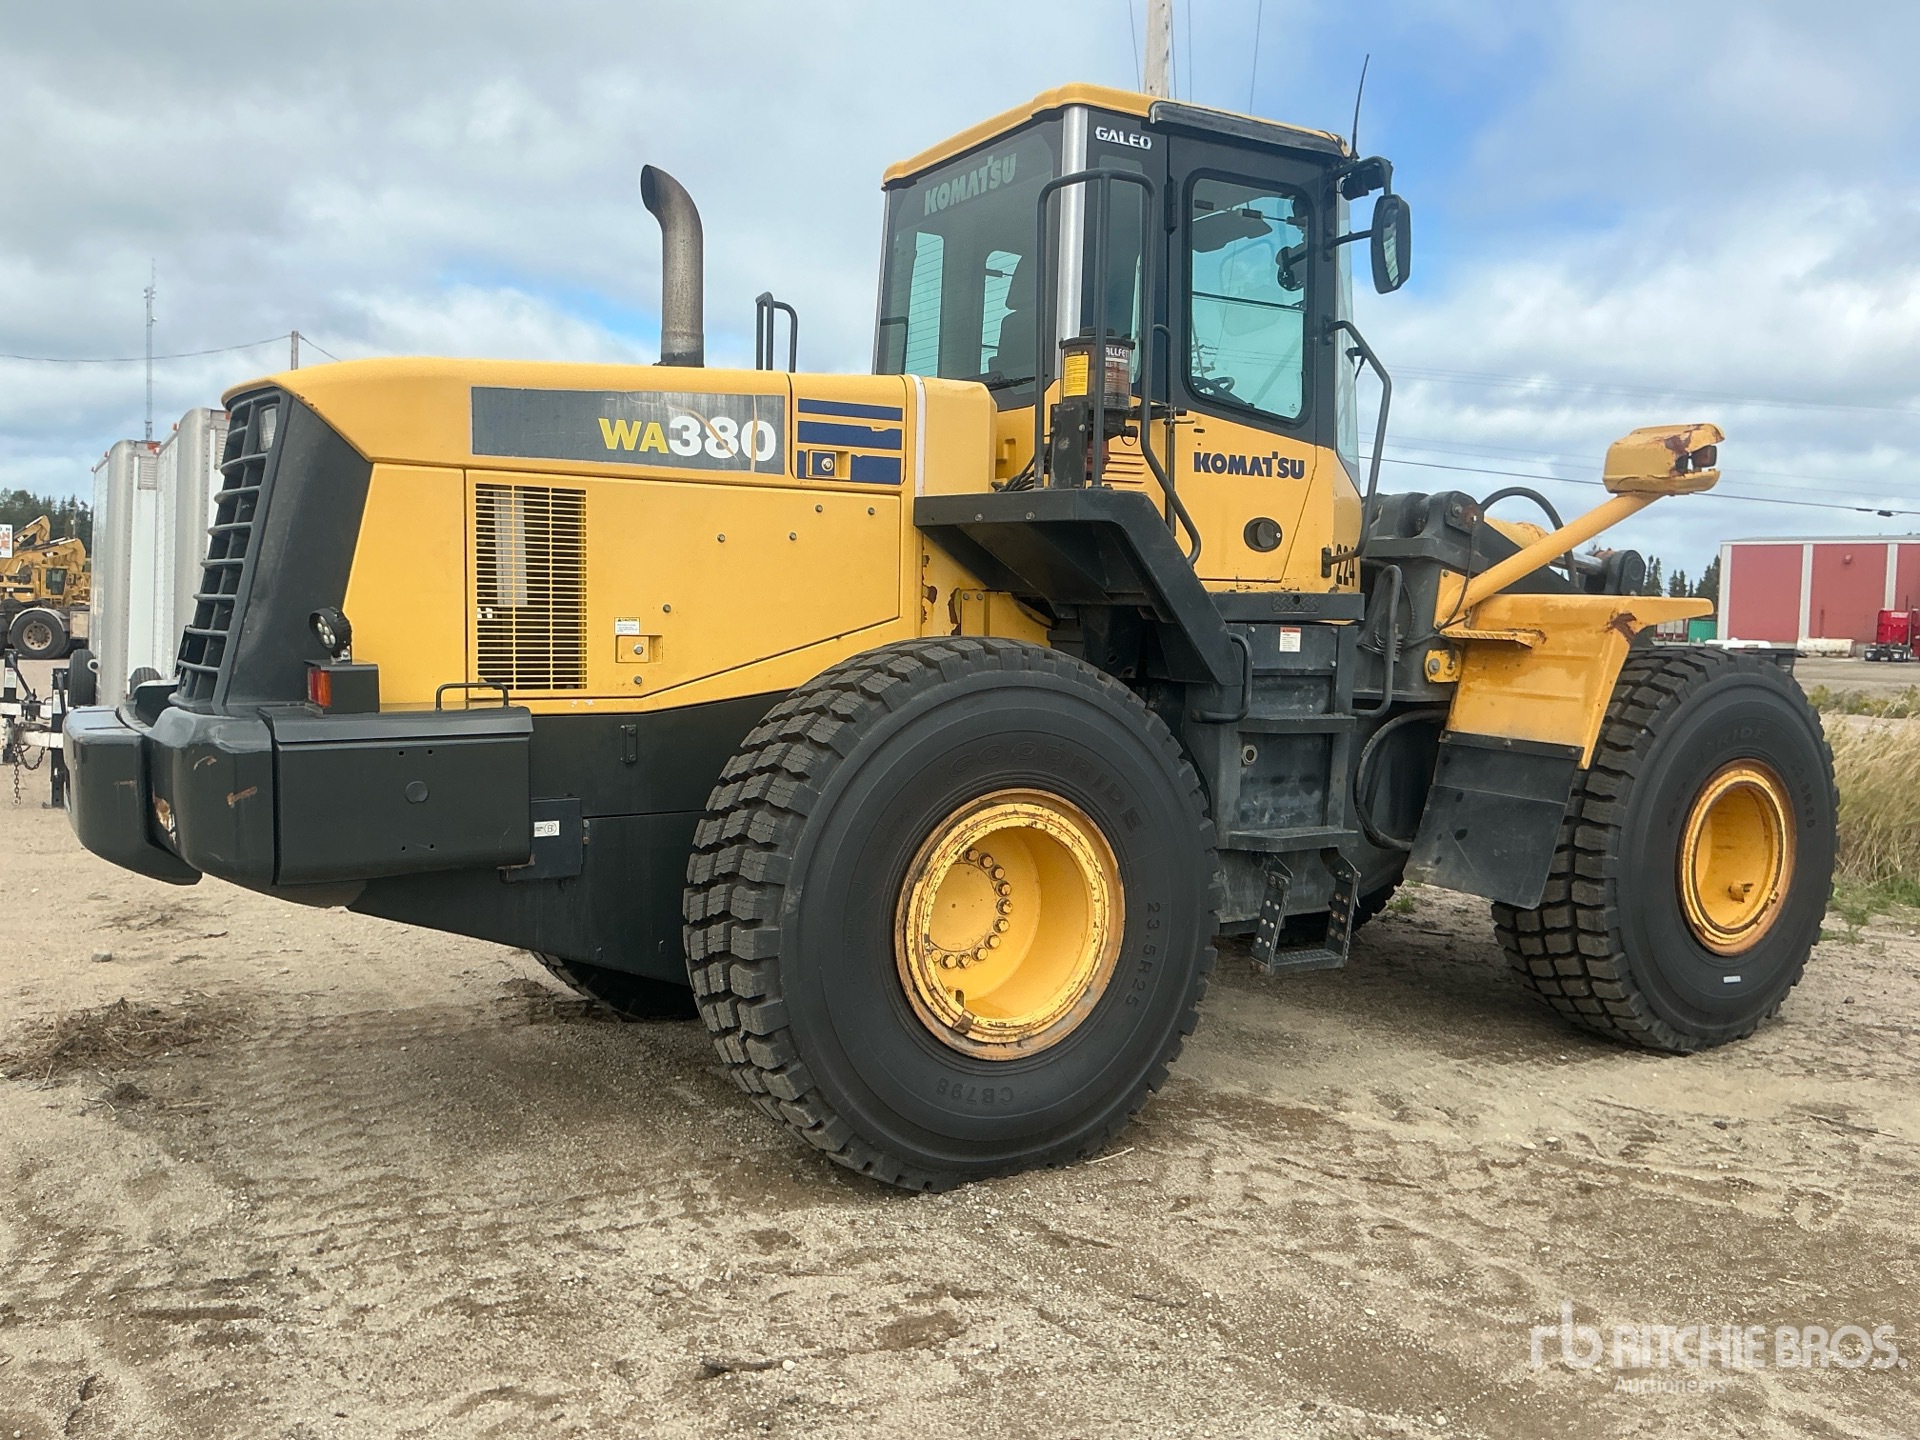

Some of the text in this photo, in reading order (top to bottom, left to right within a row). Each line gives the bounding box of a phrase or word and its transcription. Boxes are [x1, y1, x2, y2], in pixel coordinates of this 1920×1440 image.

[1095, 126, 1152, 150] GALEO
[924, 153, 1017, 216] KOMATSU
[598, 416, 776, 461] WA380
[1194, 451, 1305, 479] KOMATSU
[948, 741, 1143, 833] GOODRIDE
[1125, 901, 1160, 1008] 23.5R25
[936, 1077, 1014, 1105] CB798
